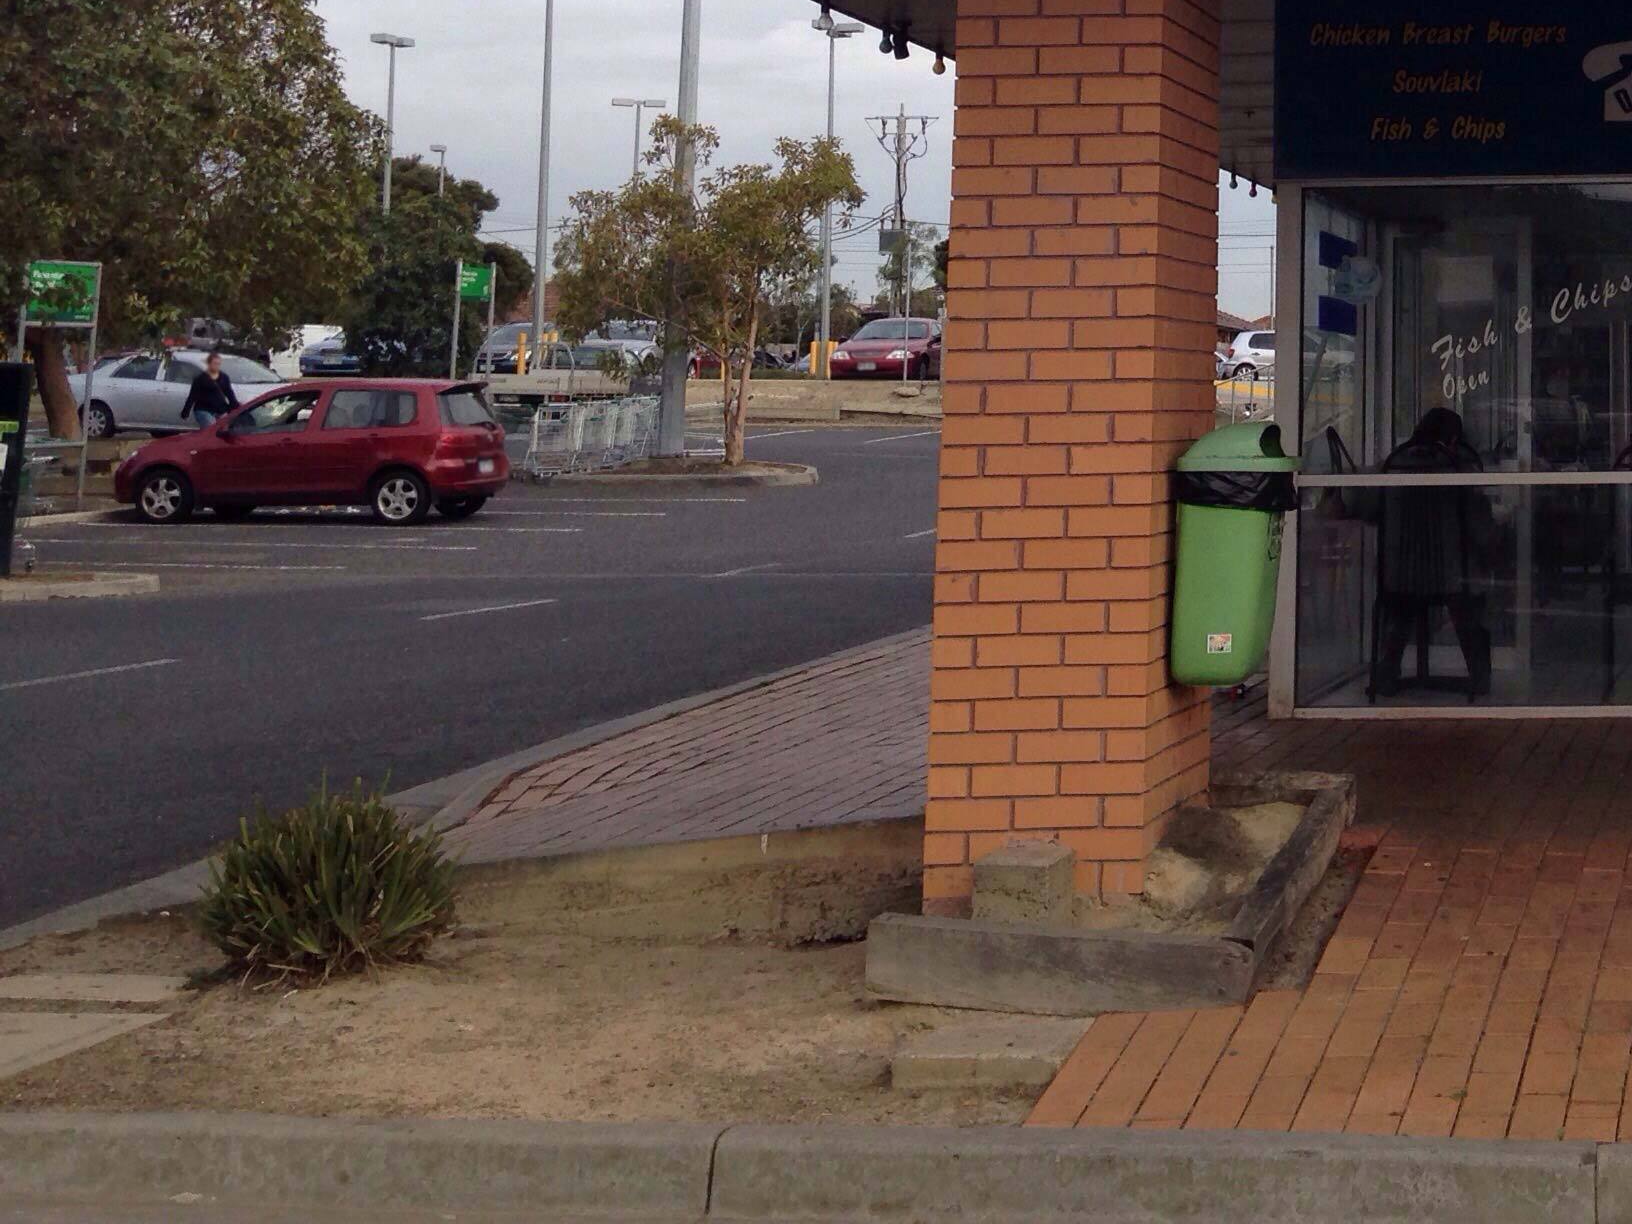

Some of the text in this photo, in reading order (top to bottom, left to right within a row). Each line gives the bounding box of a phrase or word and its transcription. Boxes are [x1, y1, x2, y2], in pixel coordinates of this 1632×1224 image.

[1309, 18, 1567, 48] Chicken Breast Burgers
[1370, 116, 1507, 143] Fish & Chips
[1431, 319, 1499, 370] Fish
[1514, 305, 1532, 334] &
[1442, 368, 1491, 403] Open
